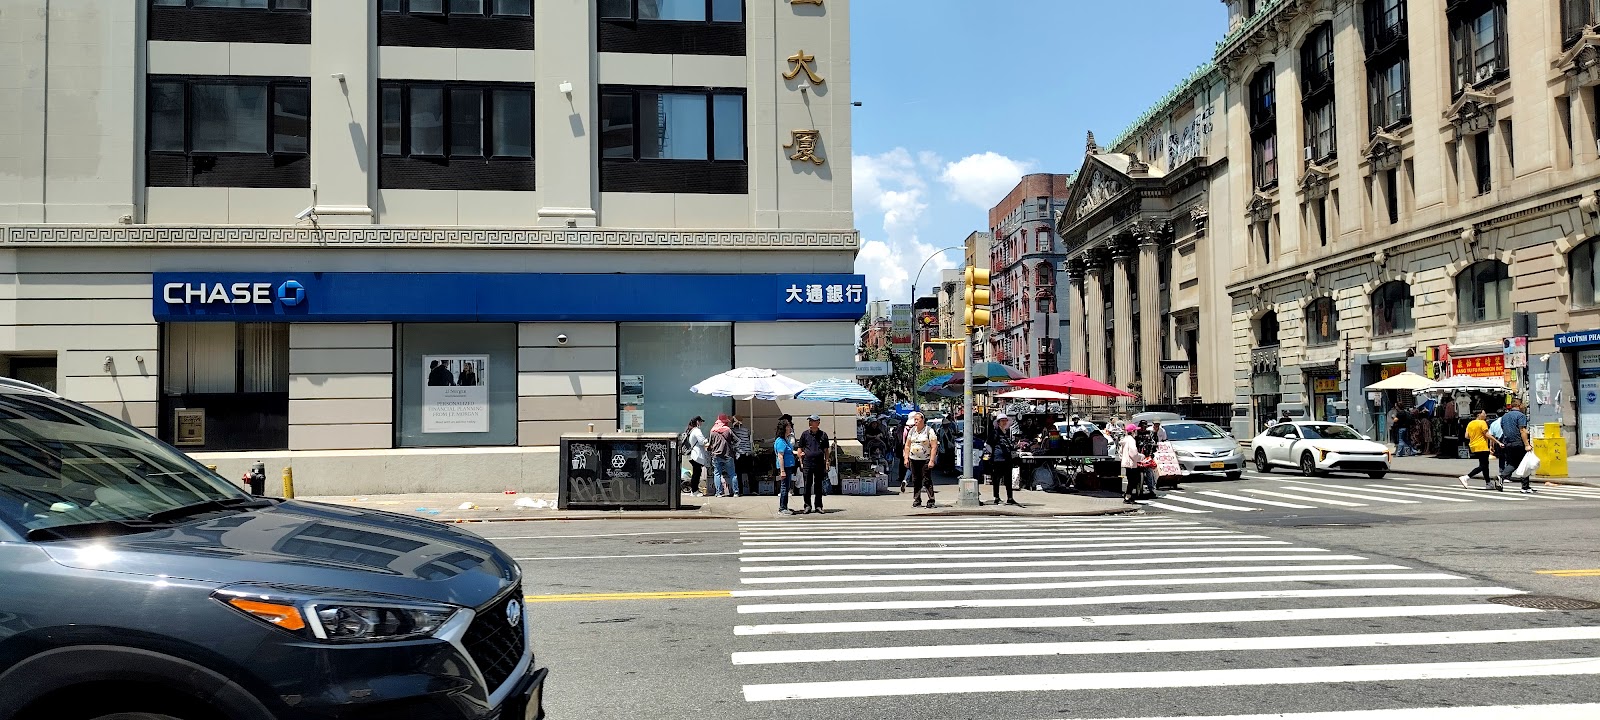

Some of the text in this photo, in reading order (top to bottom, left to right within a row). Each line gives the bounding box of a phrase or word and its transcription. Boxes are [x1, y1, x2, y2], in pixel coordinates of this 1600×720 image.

[163, 282, 272, 304] CHASE
[785, 284, 863, 304] 大通銀行
